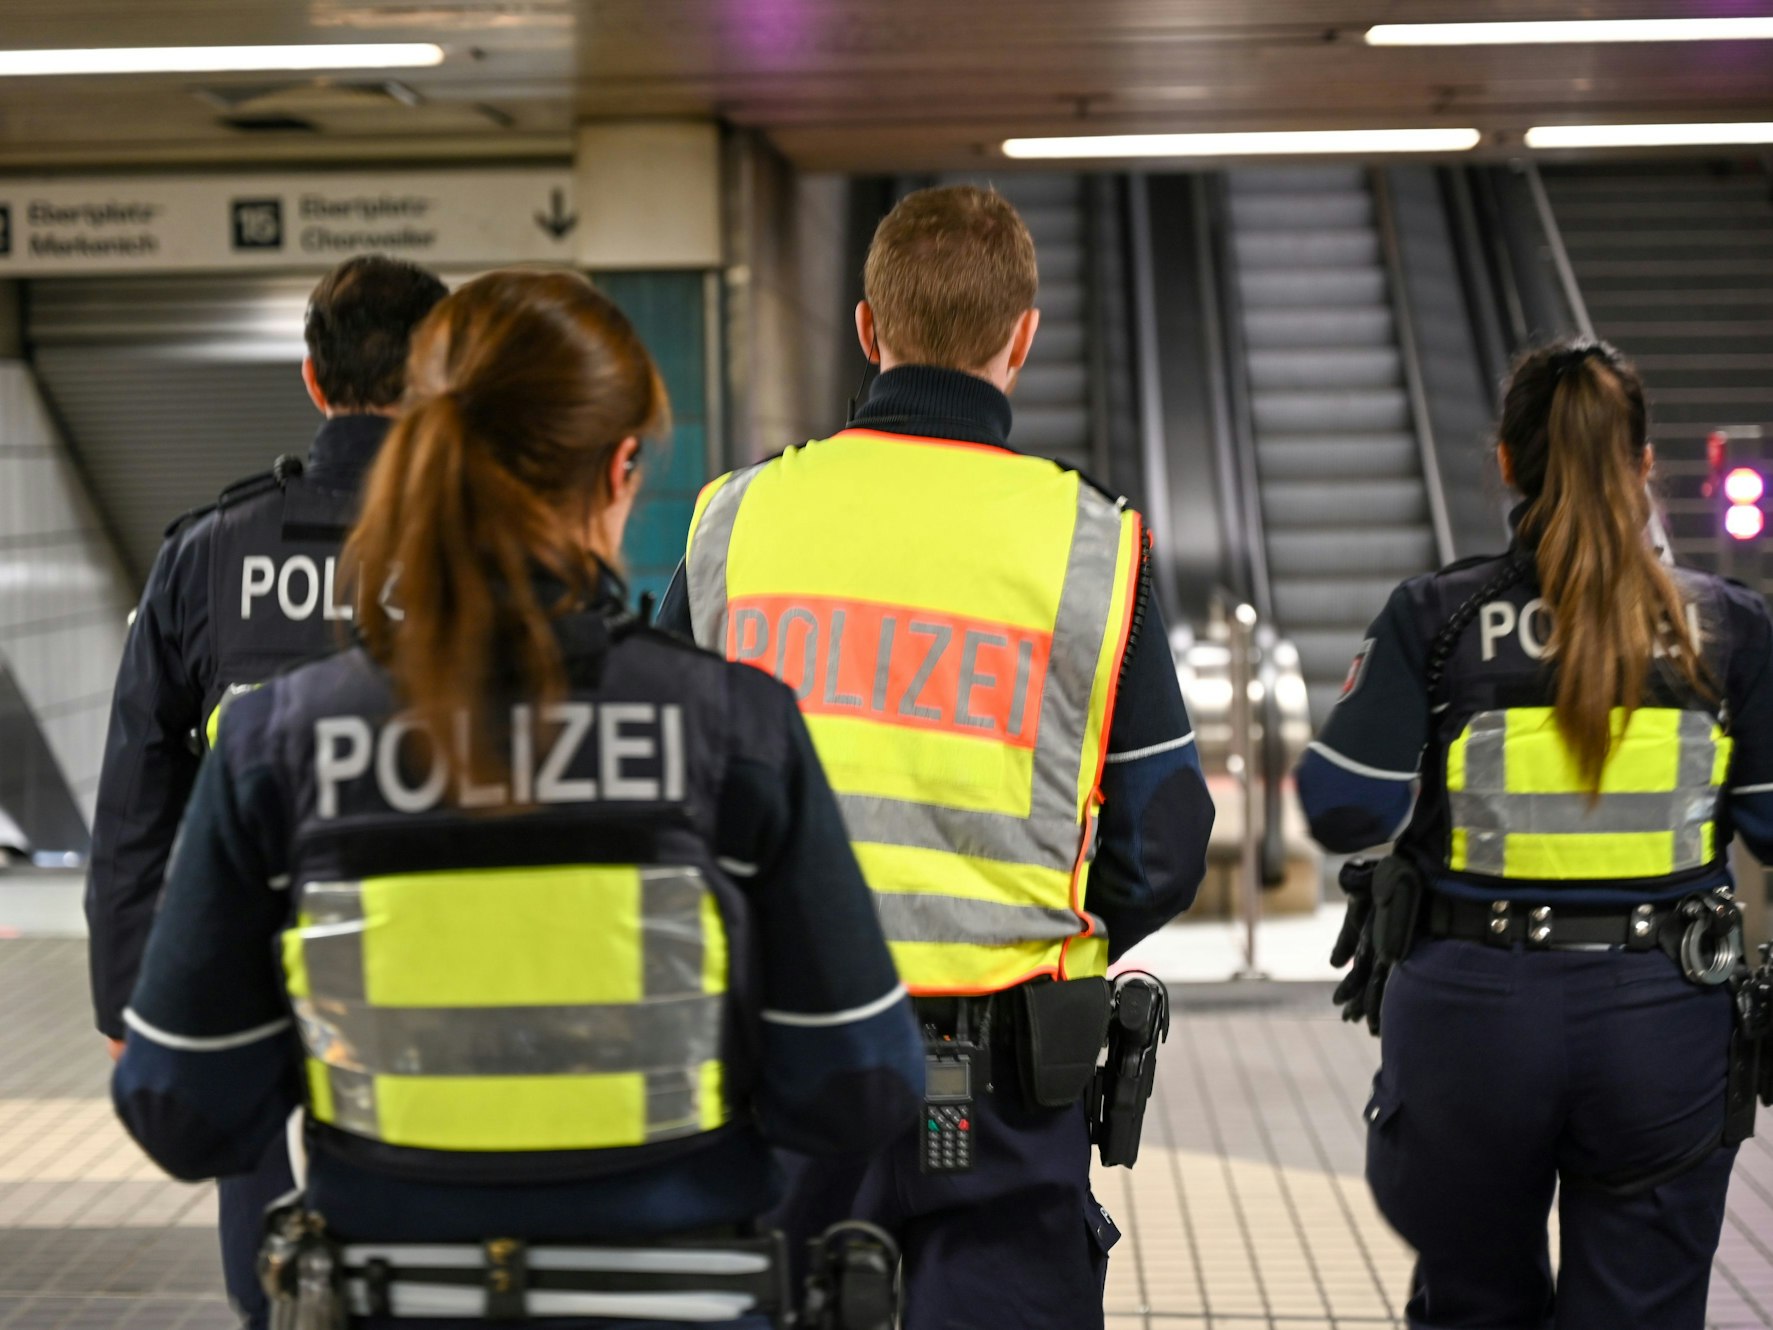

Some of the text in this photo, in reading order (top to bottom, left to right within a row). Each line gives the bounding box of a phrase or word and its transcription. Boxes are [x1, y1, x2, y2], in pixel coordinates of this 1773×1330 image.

[237, 207, 276, 245] 15
[735, 607, 1034, 737] POLIZEI
[315, 704, 685, 818] POLIZEI
